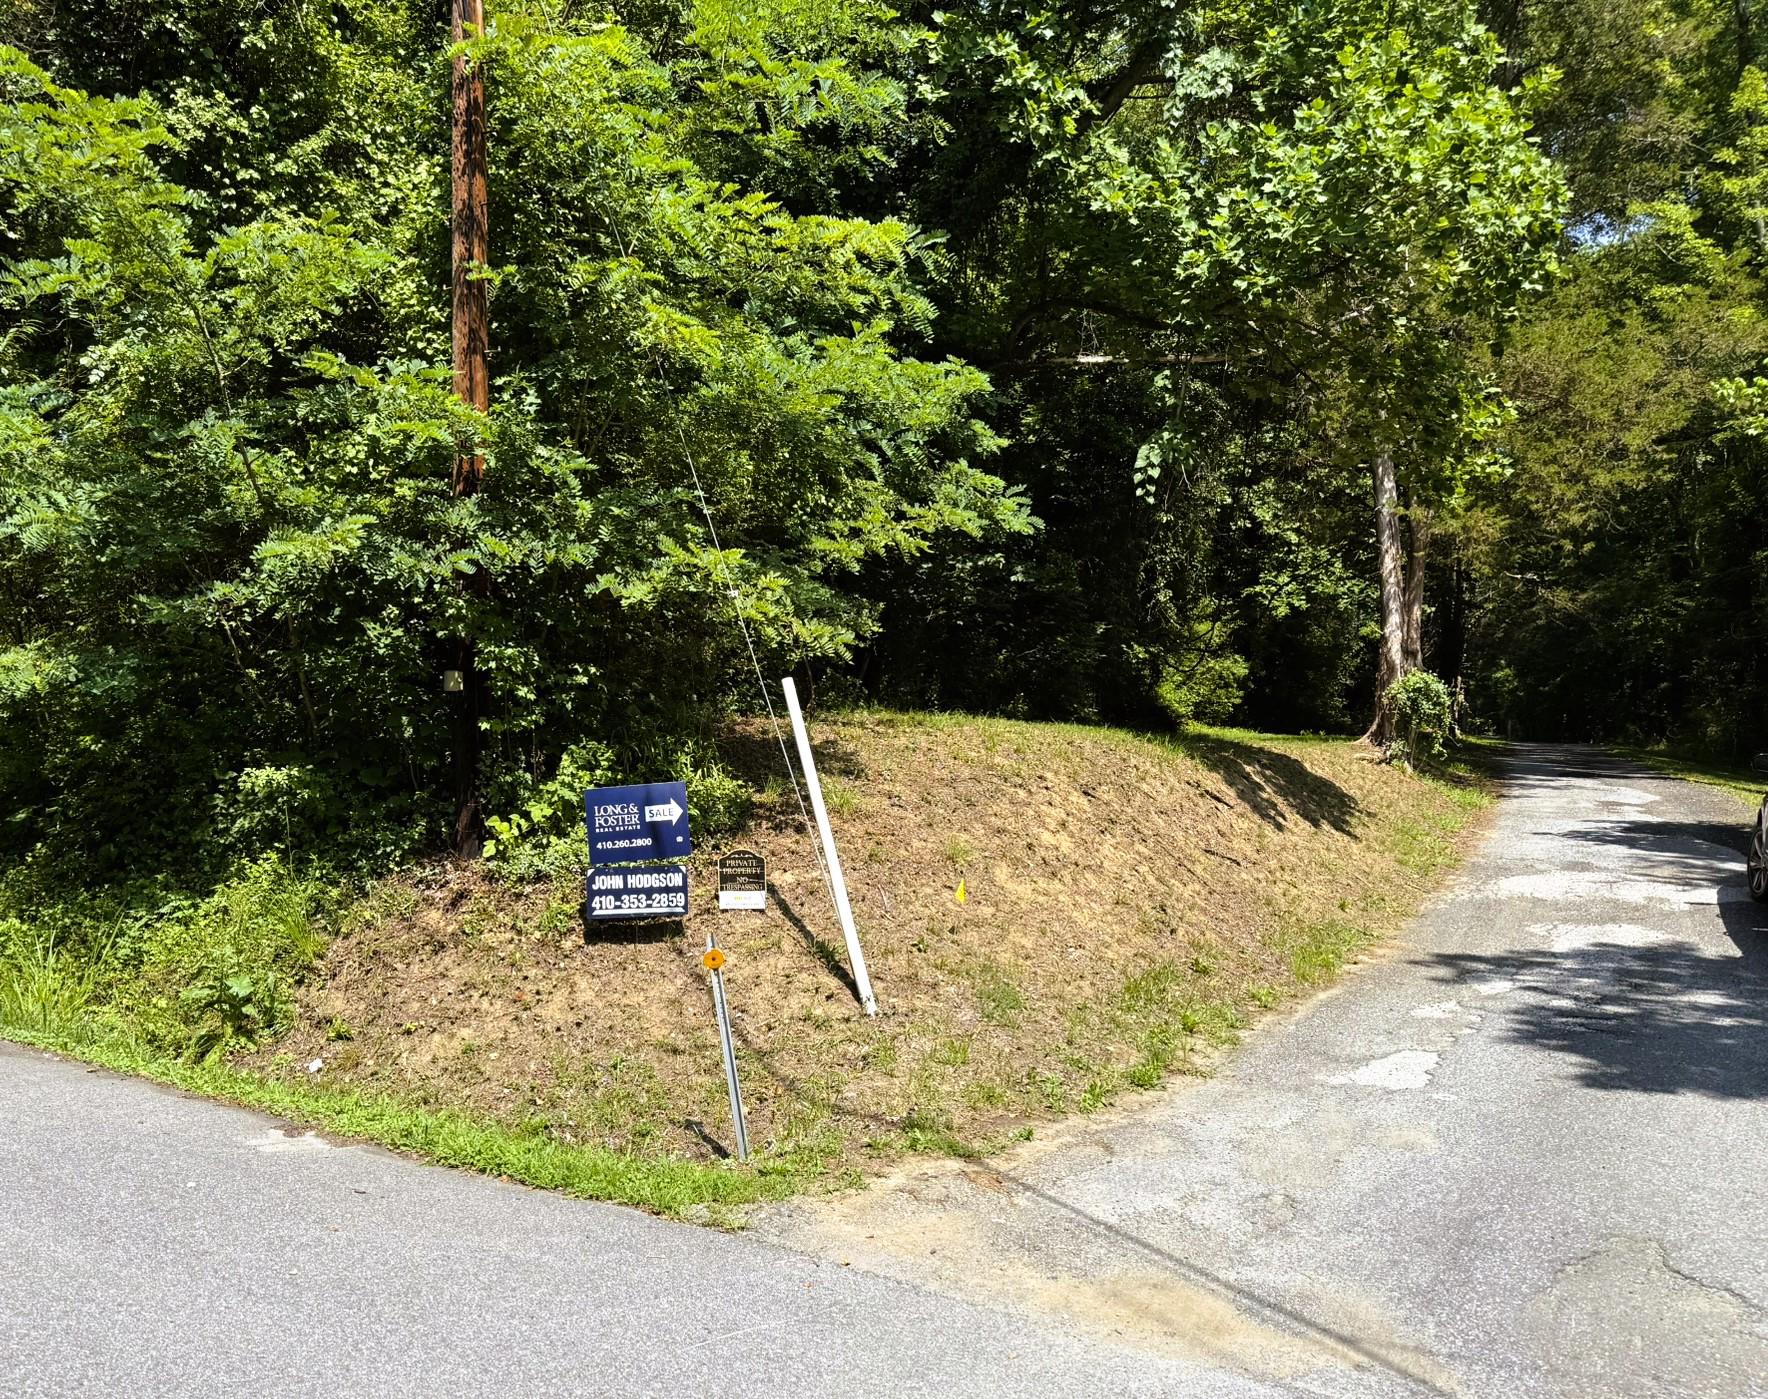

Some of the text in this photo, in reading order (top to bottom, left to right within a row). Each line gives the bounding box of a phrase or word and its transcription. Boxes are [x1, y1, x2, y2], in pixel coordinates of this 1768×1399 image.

[594, 803, 640, 817] LONG &
[648, 808, 674, 818] SALE
[594, 814, 640, 828] FOSTER
[596, 838, 652, 850] 410.260.2800
[591, 872, 683, 890] JOHN HODGSON
[591, 892, 686, 910] 410-353-2859
